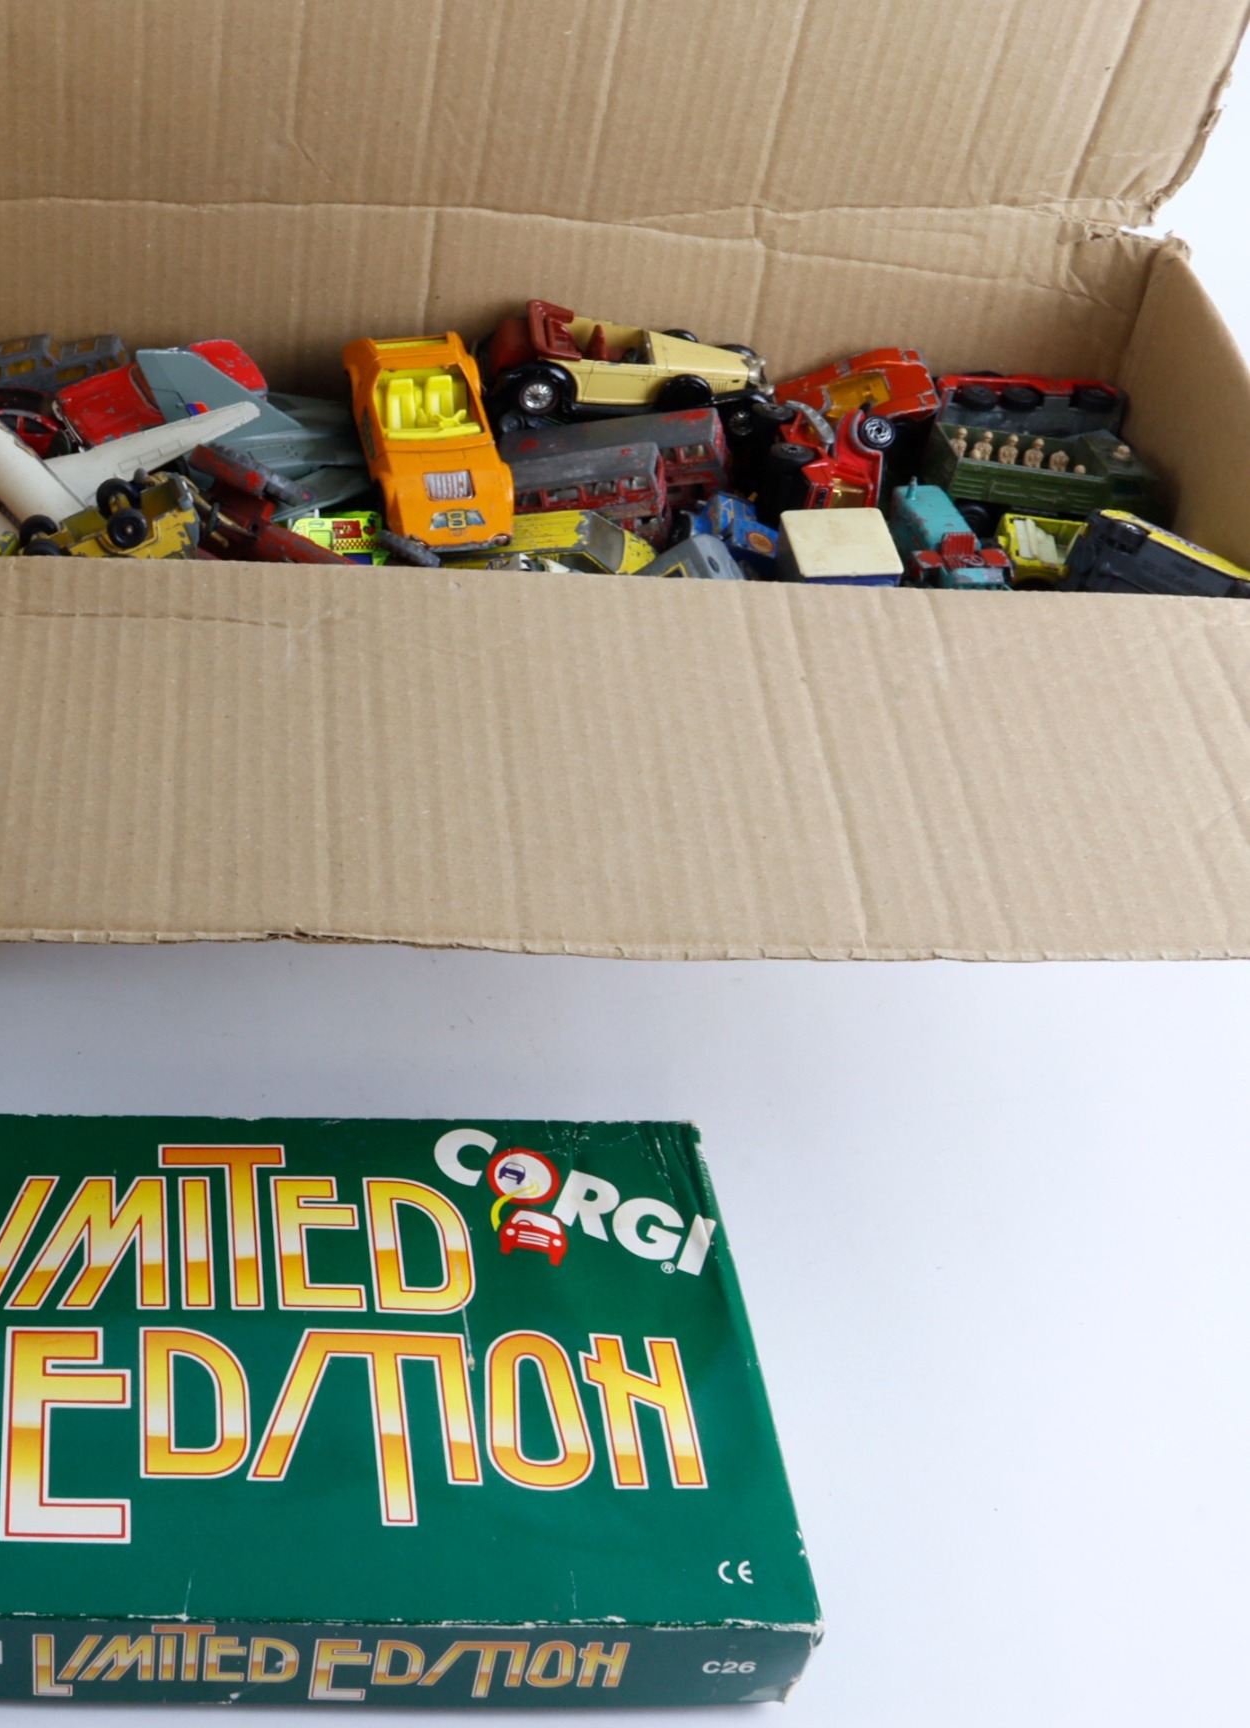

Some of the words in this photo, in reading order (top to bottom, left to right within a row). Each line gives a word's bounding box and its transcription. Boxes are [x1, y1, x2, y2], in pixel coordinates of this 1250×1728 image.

[434, 1128, 717, 1276] CORGI
[0, 1327, 708, 1544] EDITION
[32, 1625, 299, 1696] LIMITED
[308, 1639, 631, 1700] EDITION
[702, 1660, 757, 1674] C26
